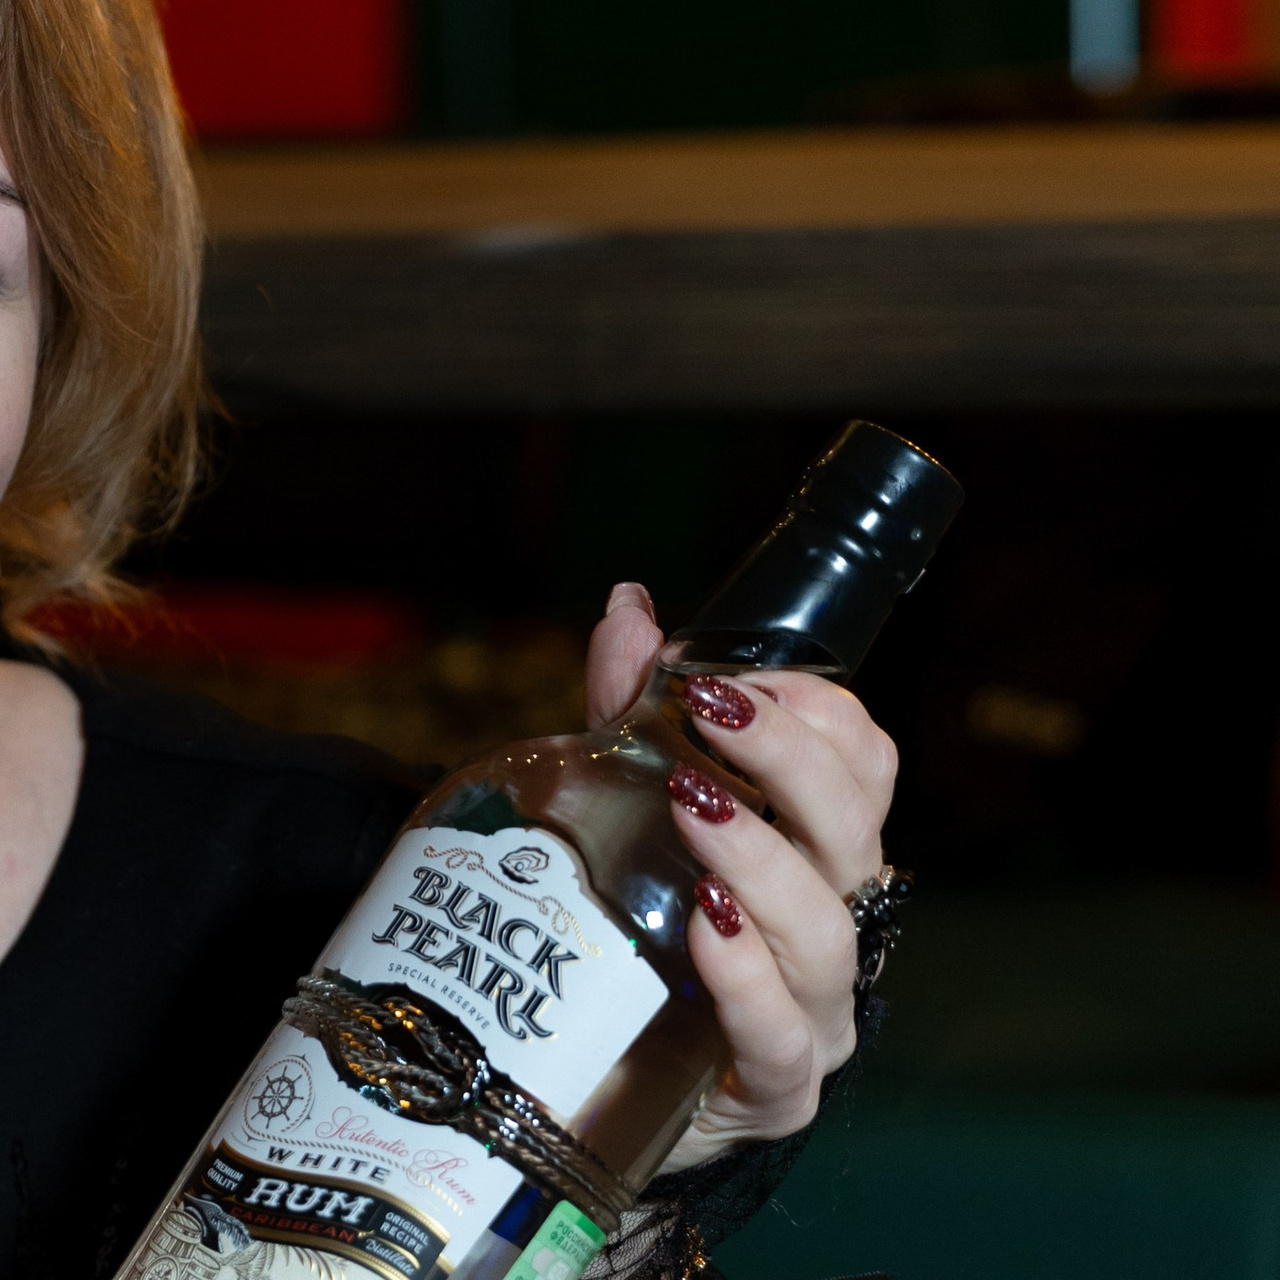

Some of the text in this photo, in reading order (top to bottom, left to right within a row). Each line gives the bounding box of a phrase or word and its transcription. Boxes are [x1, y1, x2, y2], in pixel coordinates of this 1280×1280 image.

[409, 866, 582, 1001] BLACK
[372, 904, 556, 1041] PEARL
[387, 962, 491, 1031] SPECIAL RESERVE
[213, 1158, 244, 1182] PREMIUM
[267, 1145, 394, 1185] WHITE
[315, 1106, 410, 1159] Autentic
[405, 1148, 476, 1206] Rum
[207, 1167, 238, 1192] QUALITY
[244, 1176, 374, 1224] RUM
[229, 1205, 356, 1244] CARIBBEAN
[380, 1222, 424, 1255] RECIPE
[385, 1211, 430, 1246] ORIGINAL
[365, 1236, 415, 1276] Distillate
